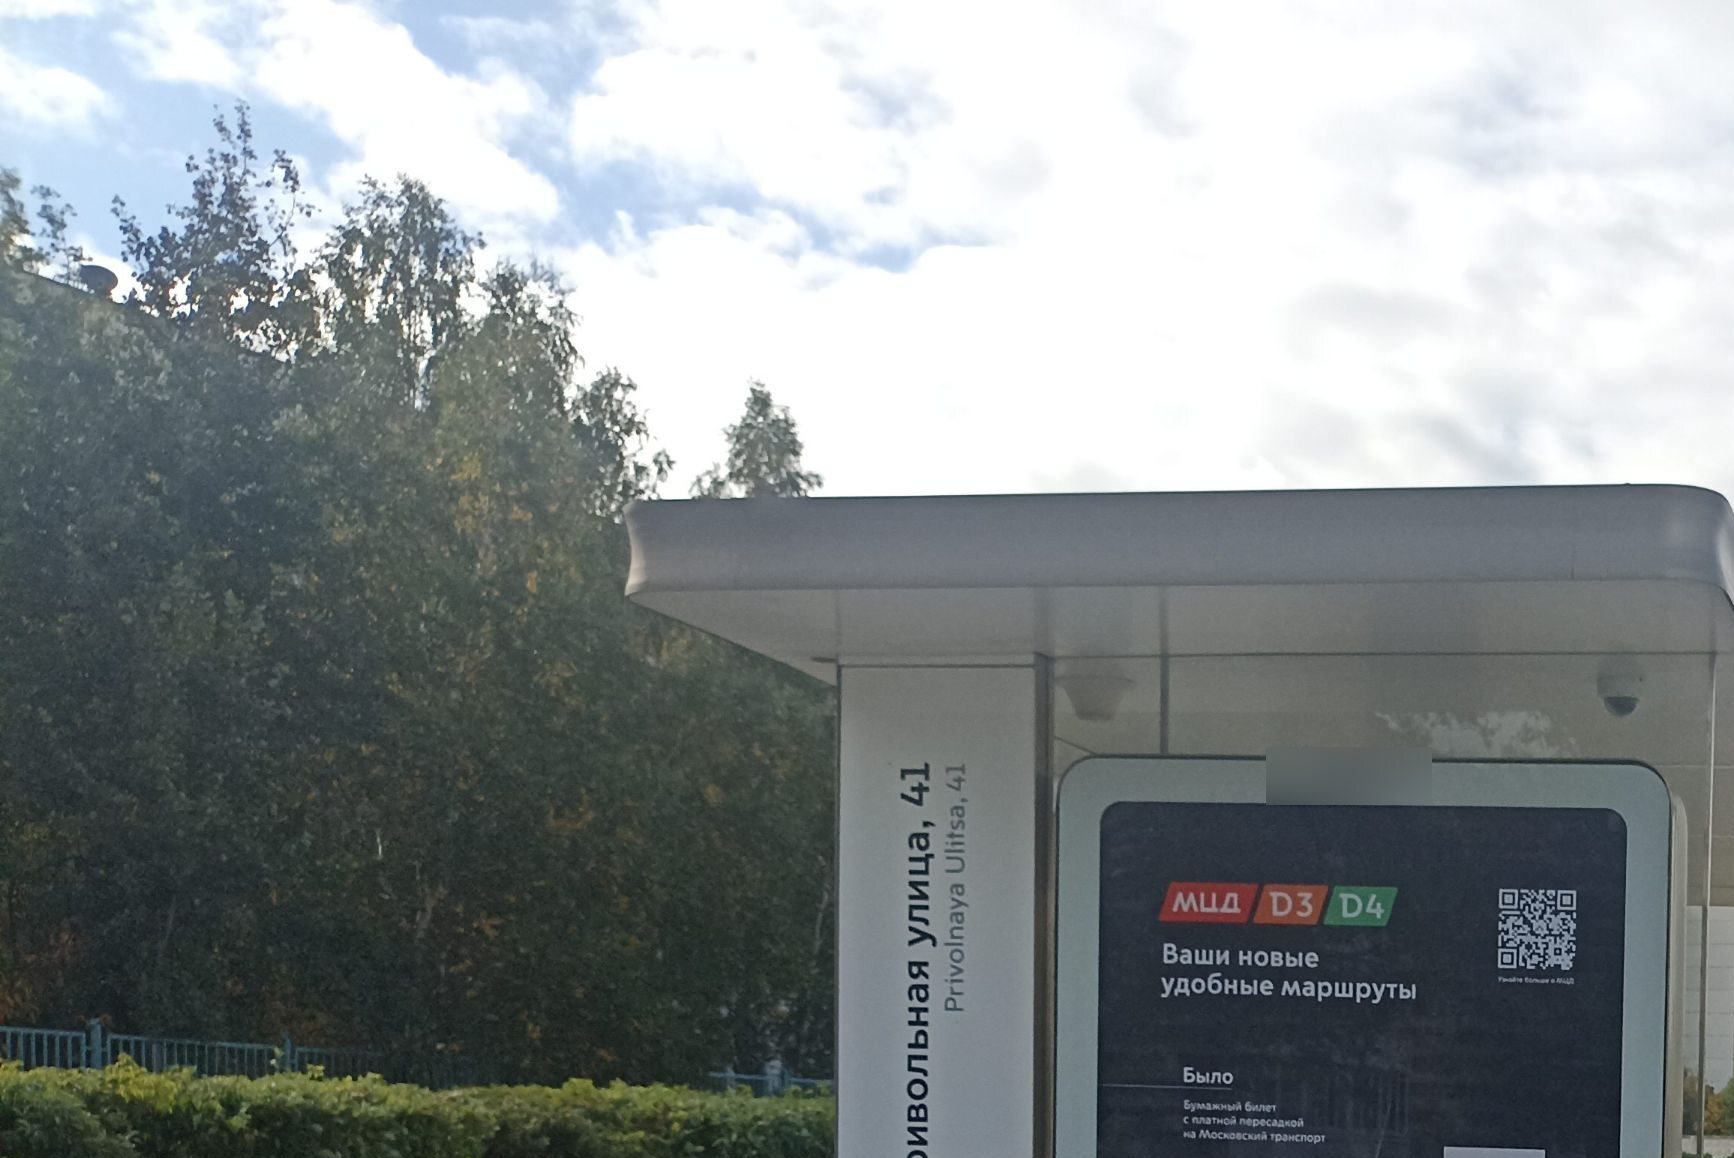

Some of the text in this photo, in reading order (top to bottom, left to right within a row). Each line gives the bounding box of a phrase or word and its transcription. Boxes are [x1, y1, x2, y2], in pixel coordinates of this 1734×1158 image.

[900, 761, 931, 807] 41
[906, 818, 937, 947] улица,
[944, 762, 969, 1012] Privolnaya Ulitsa, 41
[1171, 891, 1385, 920] МЦД D3 D4
[1161, 942, 1320, 969] Ваши новые
[1160, 972, 1418, 1004] удобные маршруты
[1182, 1066, 1234, 1085] Было
[1183, 1099, 1277, 1113] Бумажный билет
[1183, 1115, 1304, 1129] с платной пересадкой
[1183, 1129, 1326, 1145] на Московский транспорт
